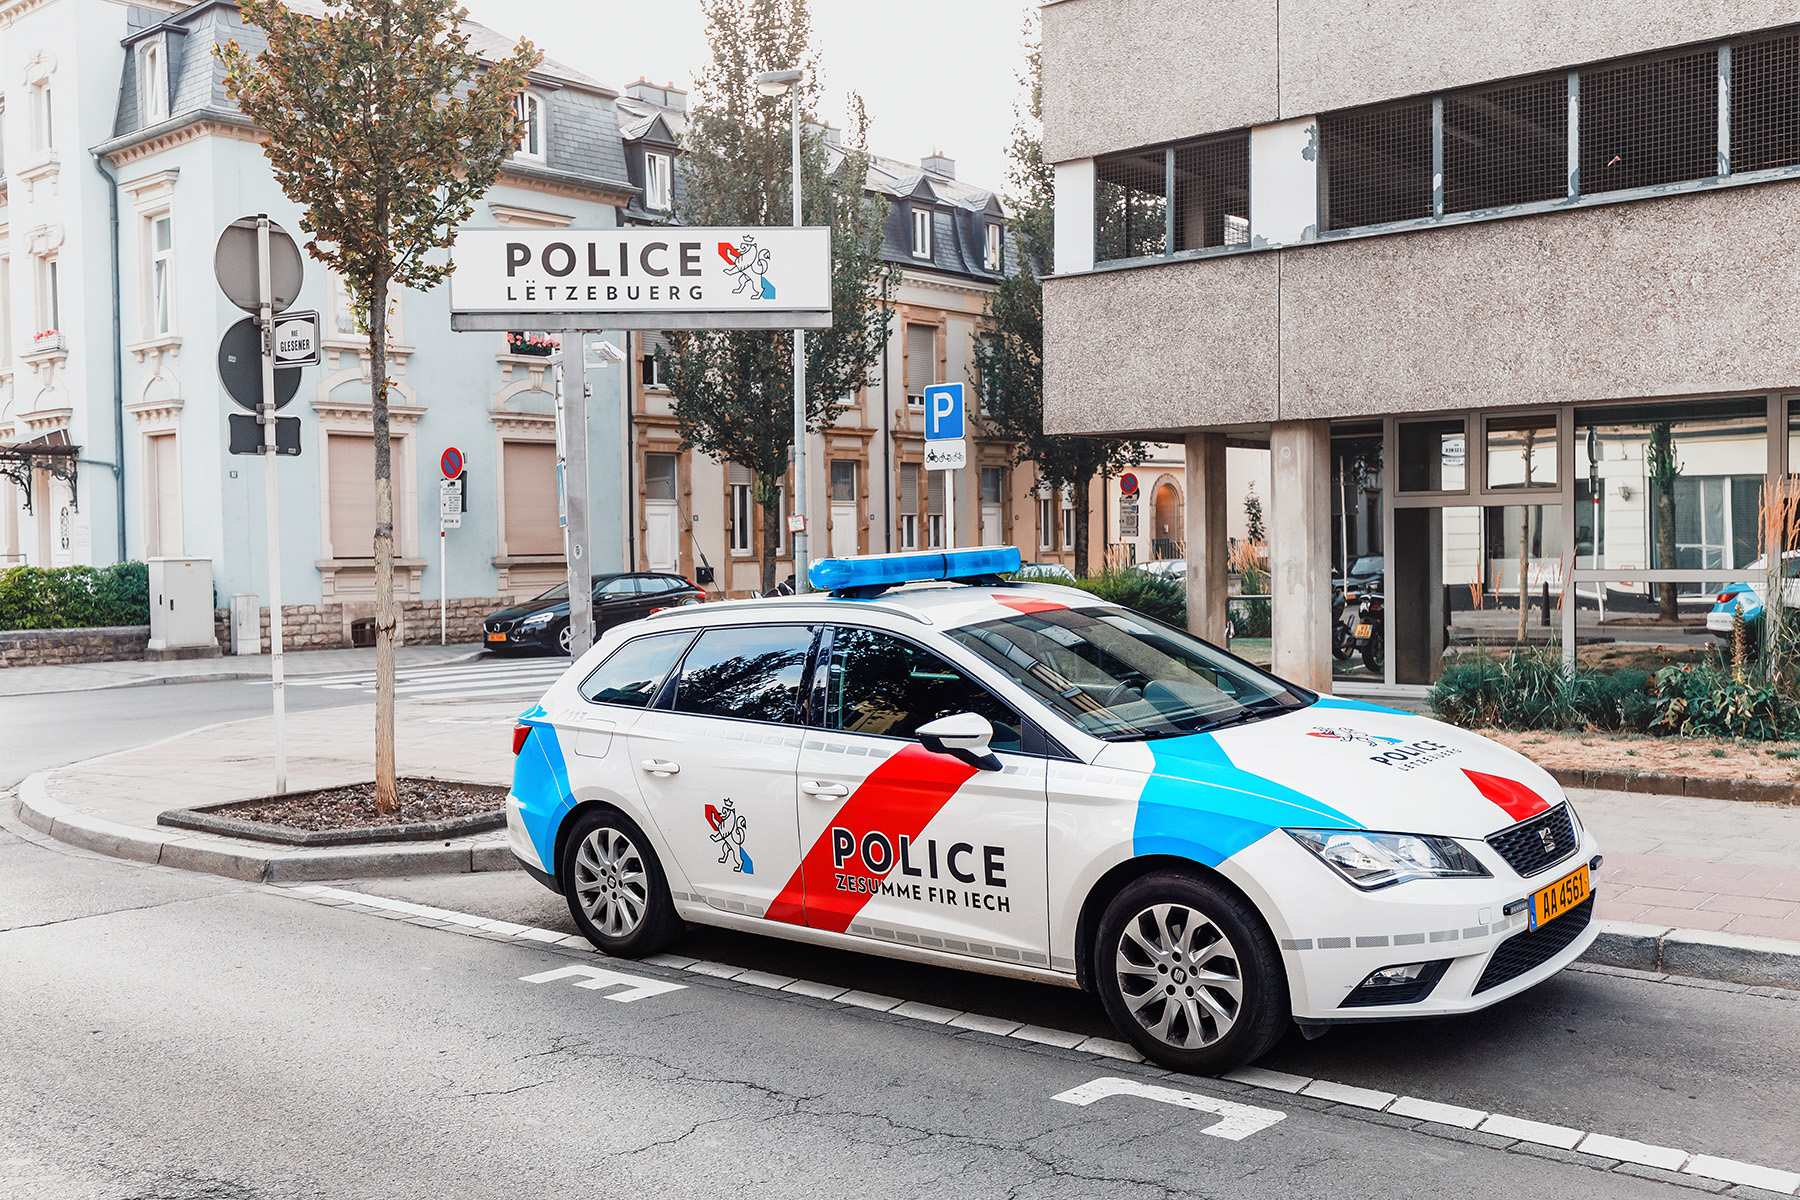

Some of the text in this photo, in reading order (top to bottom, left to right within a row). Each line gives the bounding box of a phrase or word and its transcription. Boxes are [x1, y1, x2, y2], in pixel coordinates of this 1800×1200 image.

[506, 242, 702, 277] POLICE
[507, 280, 703, 301] LËTZEBUERG
[280, 339, 311, 352] GLESENER
[933, 391, 954, 434] P
[1369, 740, 1447, 766] POLICE
[832, 826, 1007, 888] POLICE
[835, 873, 1011, 913] ZESUMME FIR IECH
[1543, 872, 1585, 919] AA 4561
